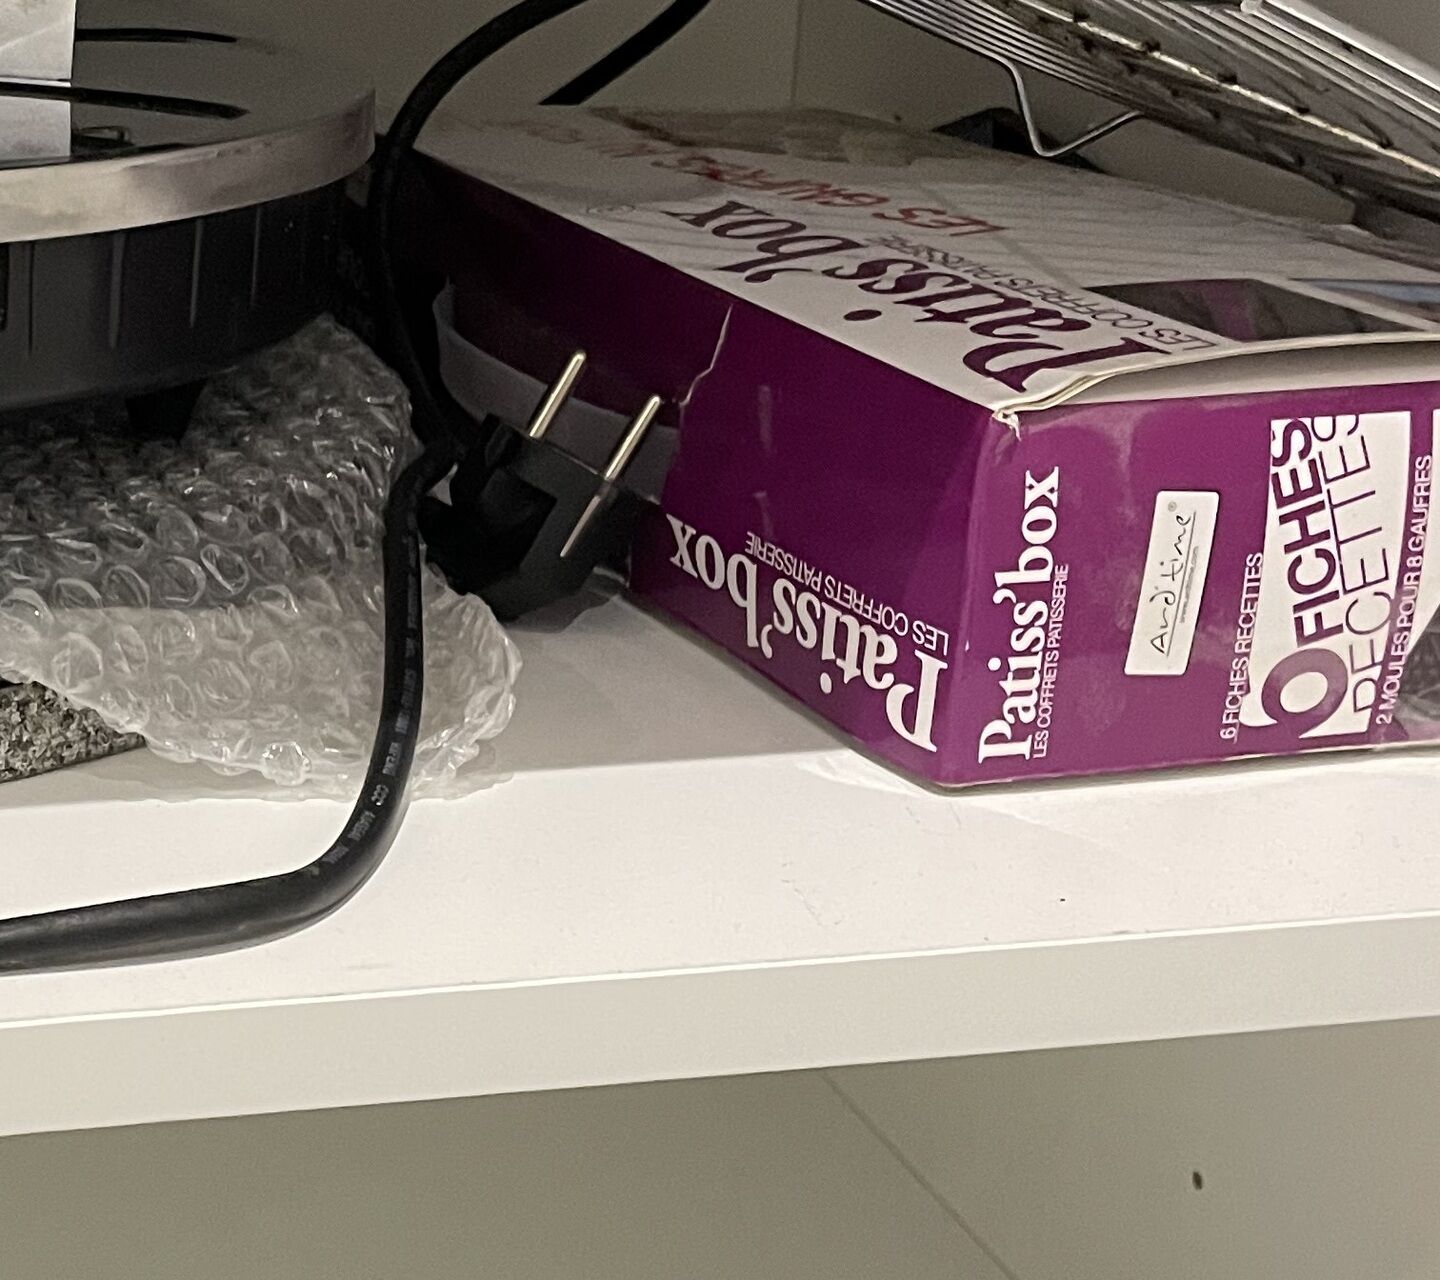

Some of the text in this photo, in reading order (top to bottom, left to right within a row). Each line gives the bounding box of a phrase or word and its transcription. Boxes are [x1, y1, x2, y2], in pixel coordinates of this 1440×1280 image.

[661, 200, 1171, 393] Patiss'box
[995, 277, 1152, 329] COFFRETS
[1141, 327, 1216, 351] LES
[666, 514, 949, 752] Patiss'box
[744, 530, 949, 656] LES COFFRETS PATISSERIE
[978, 466, 1060, 764] Patiss'box
[1032, 563, 1069, 759] LES COFFRETS PATISSERIE
[1219, 552, 1263, 740] 6 FICHES RECETTES
[1376, 455, 1432, 725] 2 MOULES POUR 8 GAUFRES
